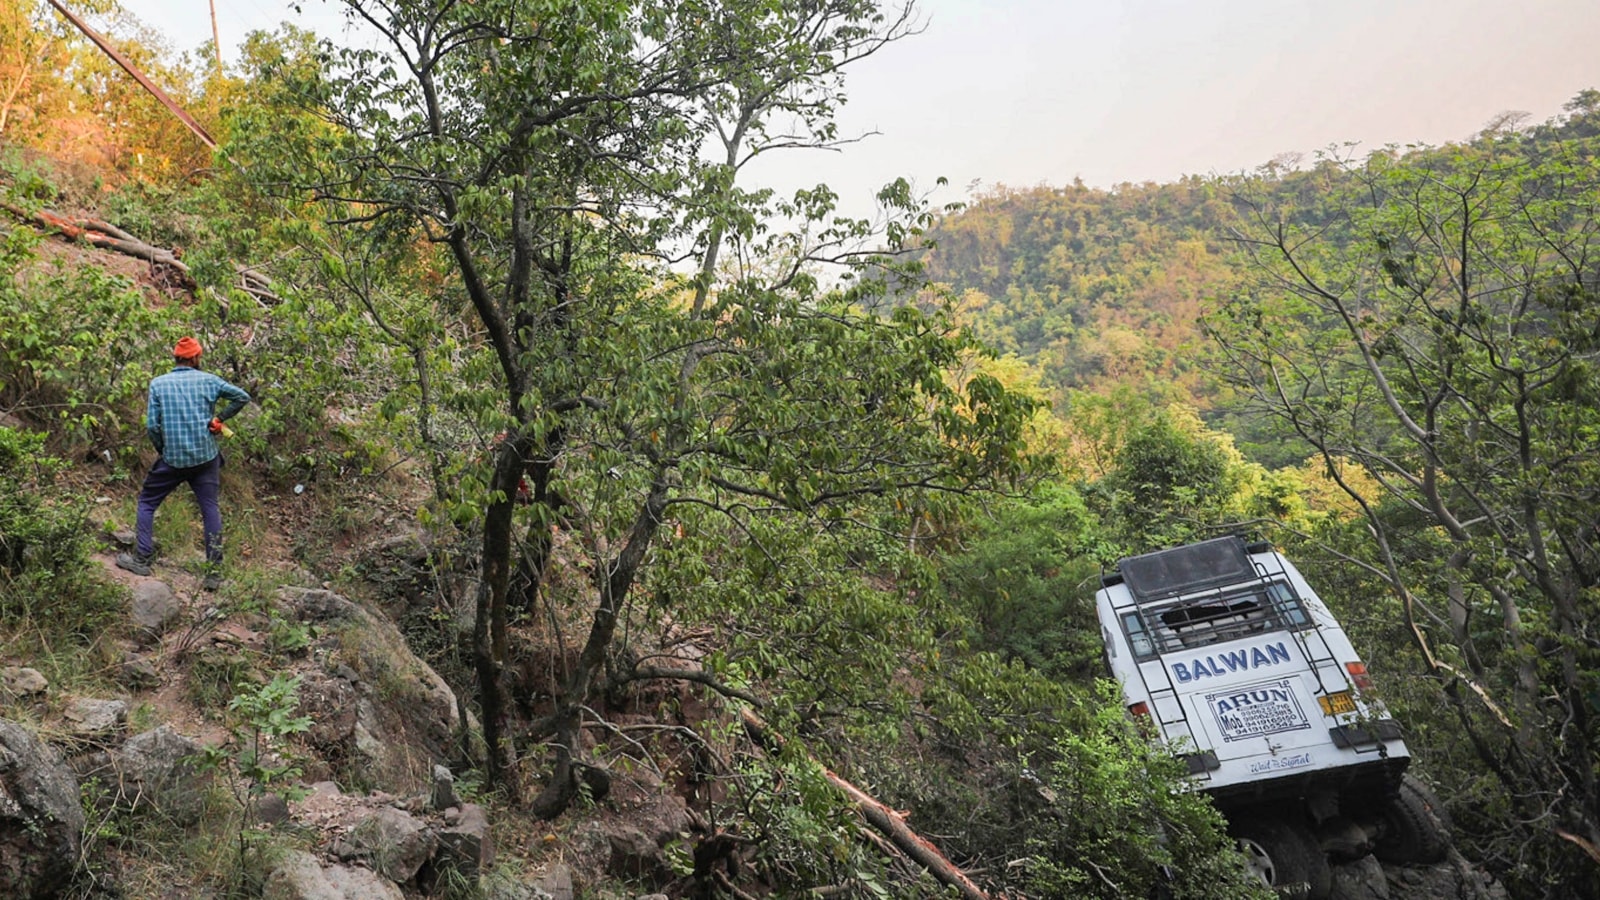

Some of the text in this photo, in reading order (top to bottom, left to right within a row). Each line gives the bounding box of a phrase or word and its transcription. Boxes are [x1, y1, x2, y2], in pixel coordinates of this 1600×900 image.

[1171, 642, 1291, 684] BALWAN
[1217, 689, 1289, 715] ARUN
[1220, 713, 1244, 731] Mob
